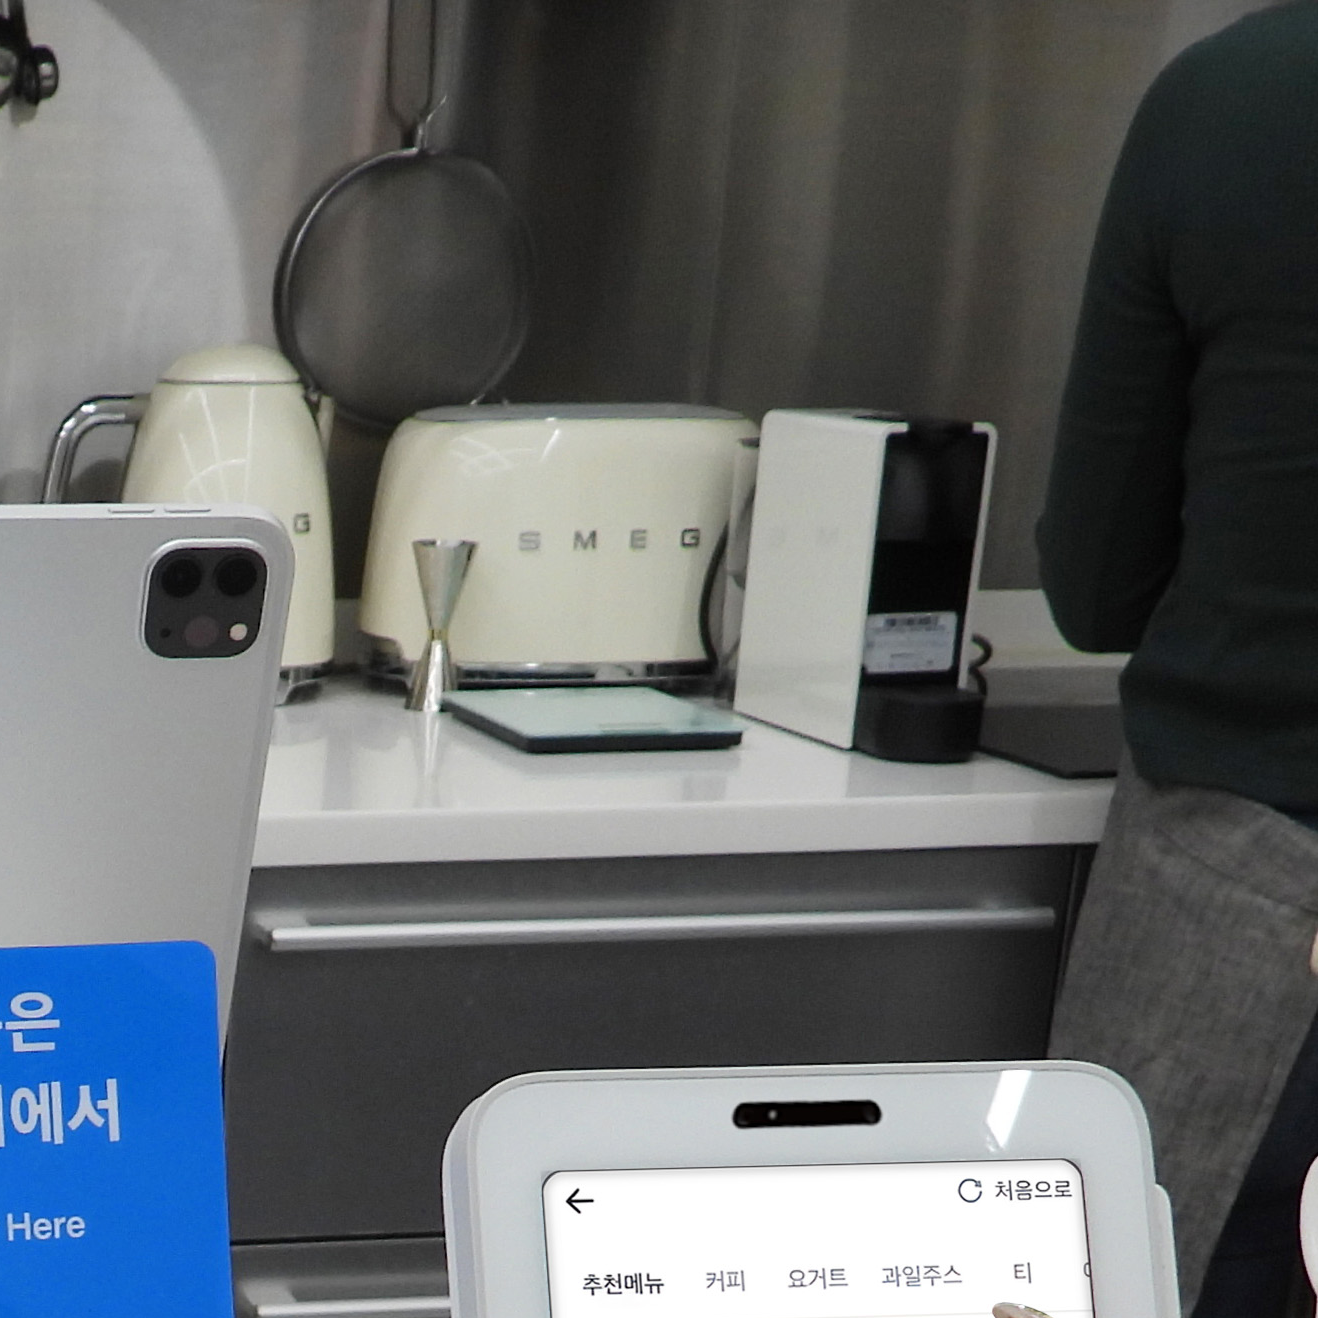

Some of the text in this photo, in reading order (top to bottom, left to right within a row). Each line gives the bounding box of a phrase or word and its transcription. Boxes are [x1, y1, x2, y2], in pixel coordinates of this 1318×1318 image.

[518, 527, 701, 551] SMEG
[995, 1179, 1073, 1201] 처음으로
[7, 1212, 86, 1242] Here
[582, 1261, 1032, 1296] 추천메뉴 커피 요거트 과일주스 티
